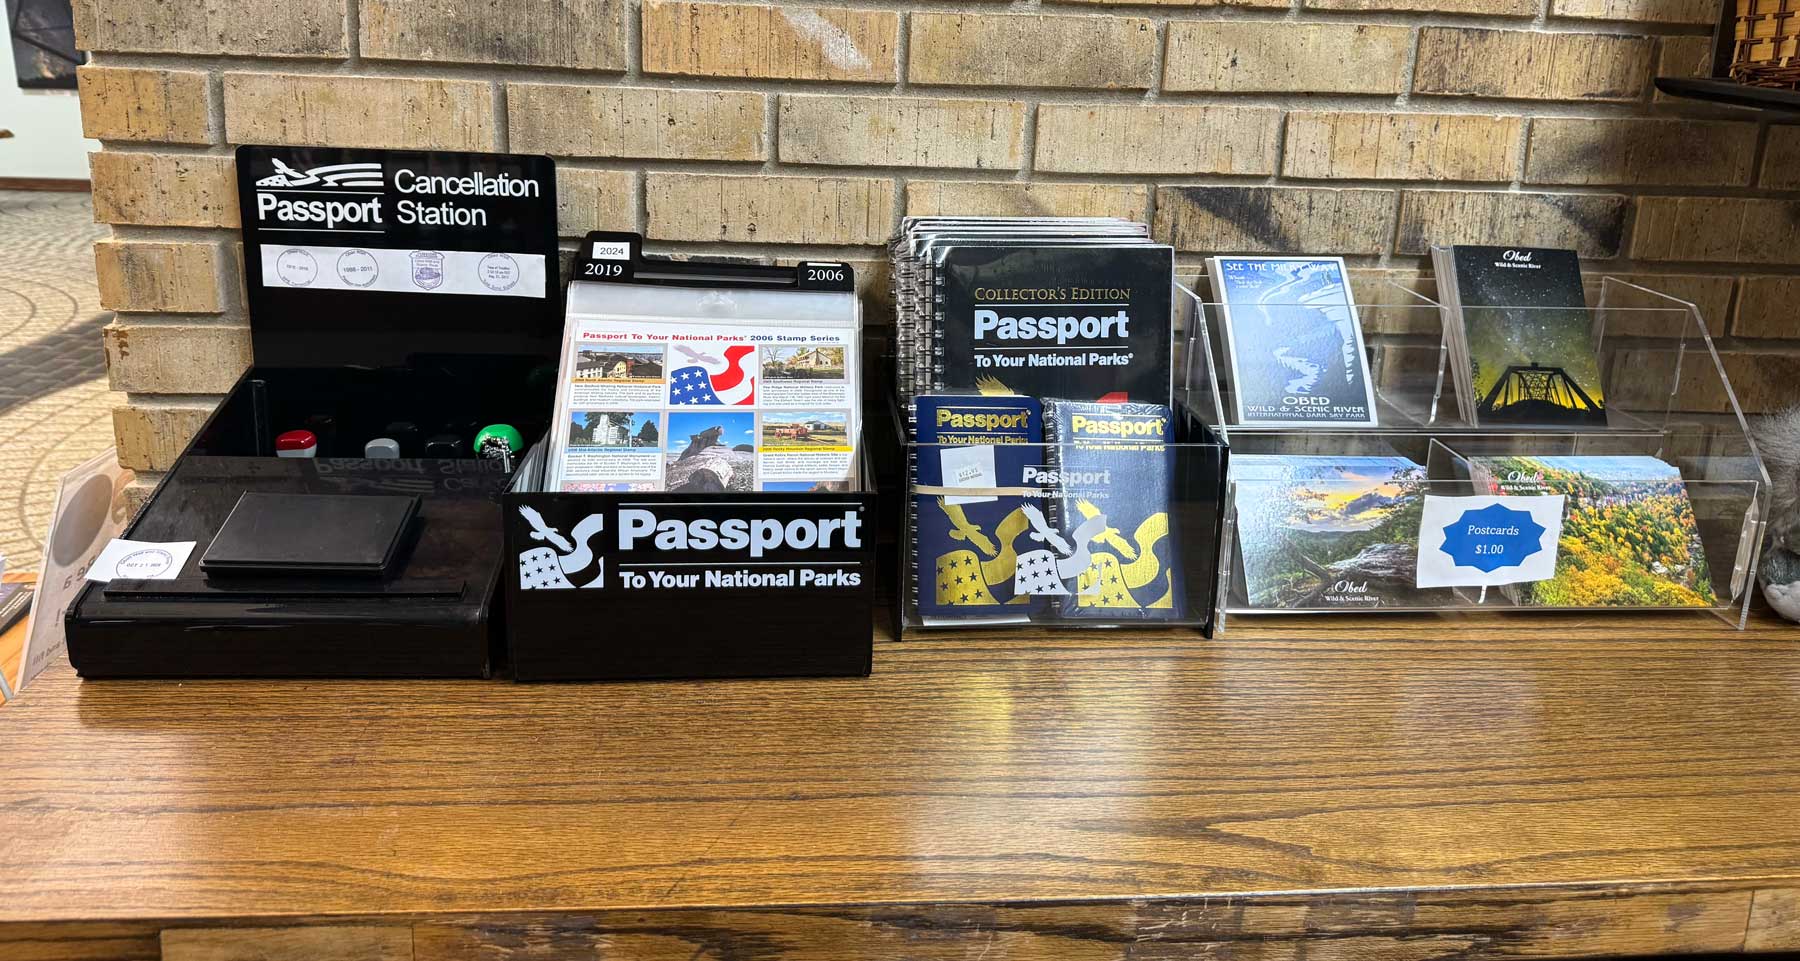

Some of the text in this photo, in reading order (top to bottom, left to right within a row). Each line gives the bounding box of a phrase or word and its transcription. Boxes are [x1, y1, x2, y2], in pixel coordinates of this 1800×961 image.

[394, 168, 540, 198] Cancellation
[257, 192, 383, 229] Passport
[396, 200, 487, 226] Station
[599, 246, 625, 256] 2024
[1502, 250, 1532, 262] Obed
[584, 263, 623, 277] 2019
[1226, 263, 1244, 271] SEE
[1247, 263, 1267, 271] THE
[806, 268, 844, 282] 2006
[1071, 288, 1131, 300] EDITION
[974, 310, 1130, 344] Passport
[583, 332, 628, 341] Passport
[776, 335, 807, 343] Stamp
[974, 354, 990, 368] To
[992, 354, 1024, 368] Your
[1028, 353, 1086, 367] National
[1282, 396, 1330, 405] OBED
[936, 408, 1028, 431] Passport
[1072, 415, 1164, 438] Passport
[948, 435, 967, 444] Your
[968, 435, 1003, 444] National
[1022, 467, 1111, 487] Passport
[618, 508, 862, 558] Passport
[1466, 524, 1520, 536] Postcards
[1475, 544, 1504, 555] $1.00
[619, 569, 861, 589] To Your National Parks
[1334, 580, 1368, 593] Obed
